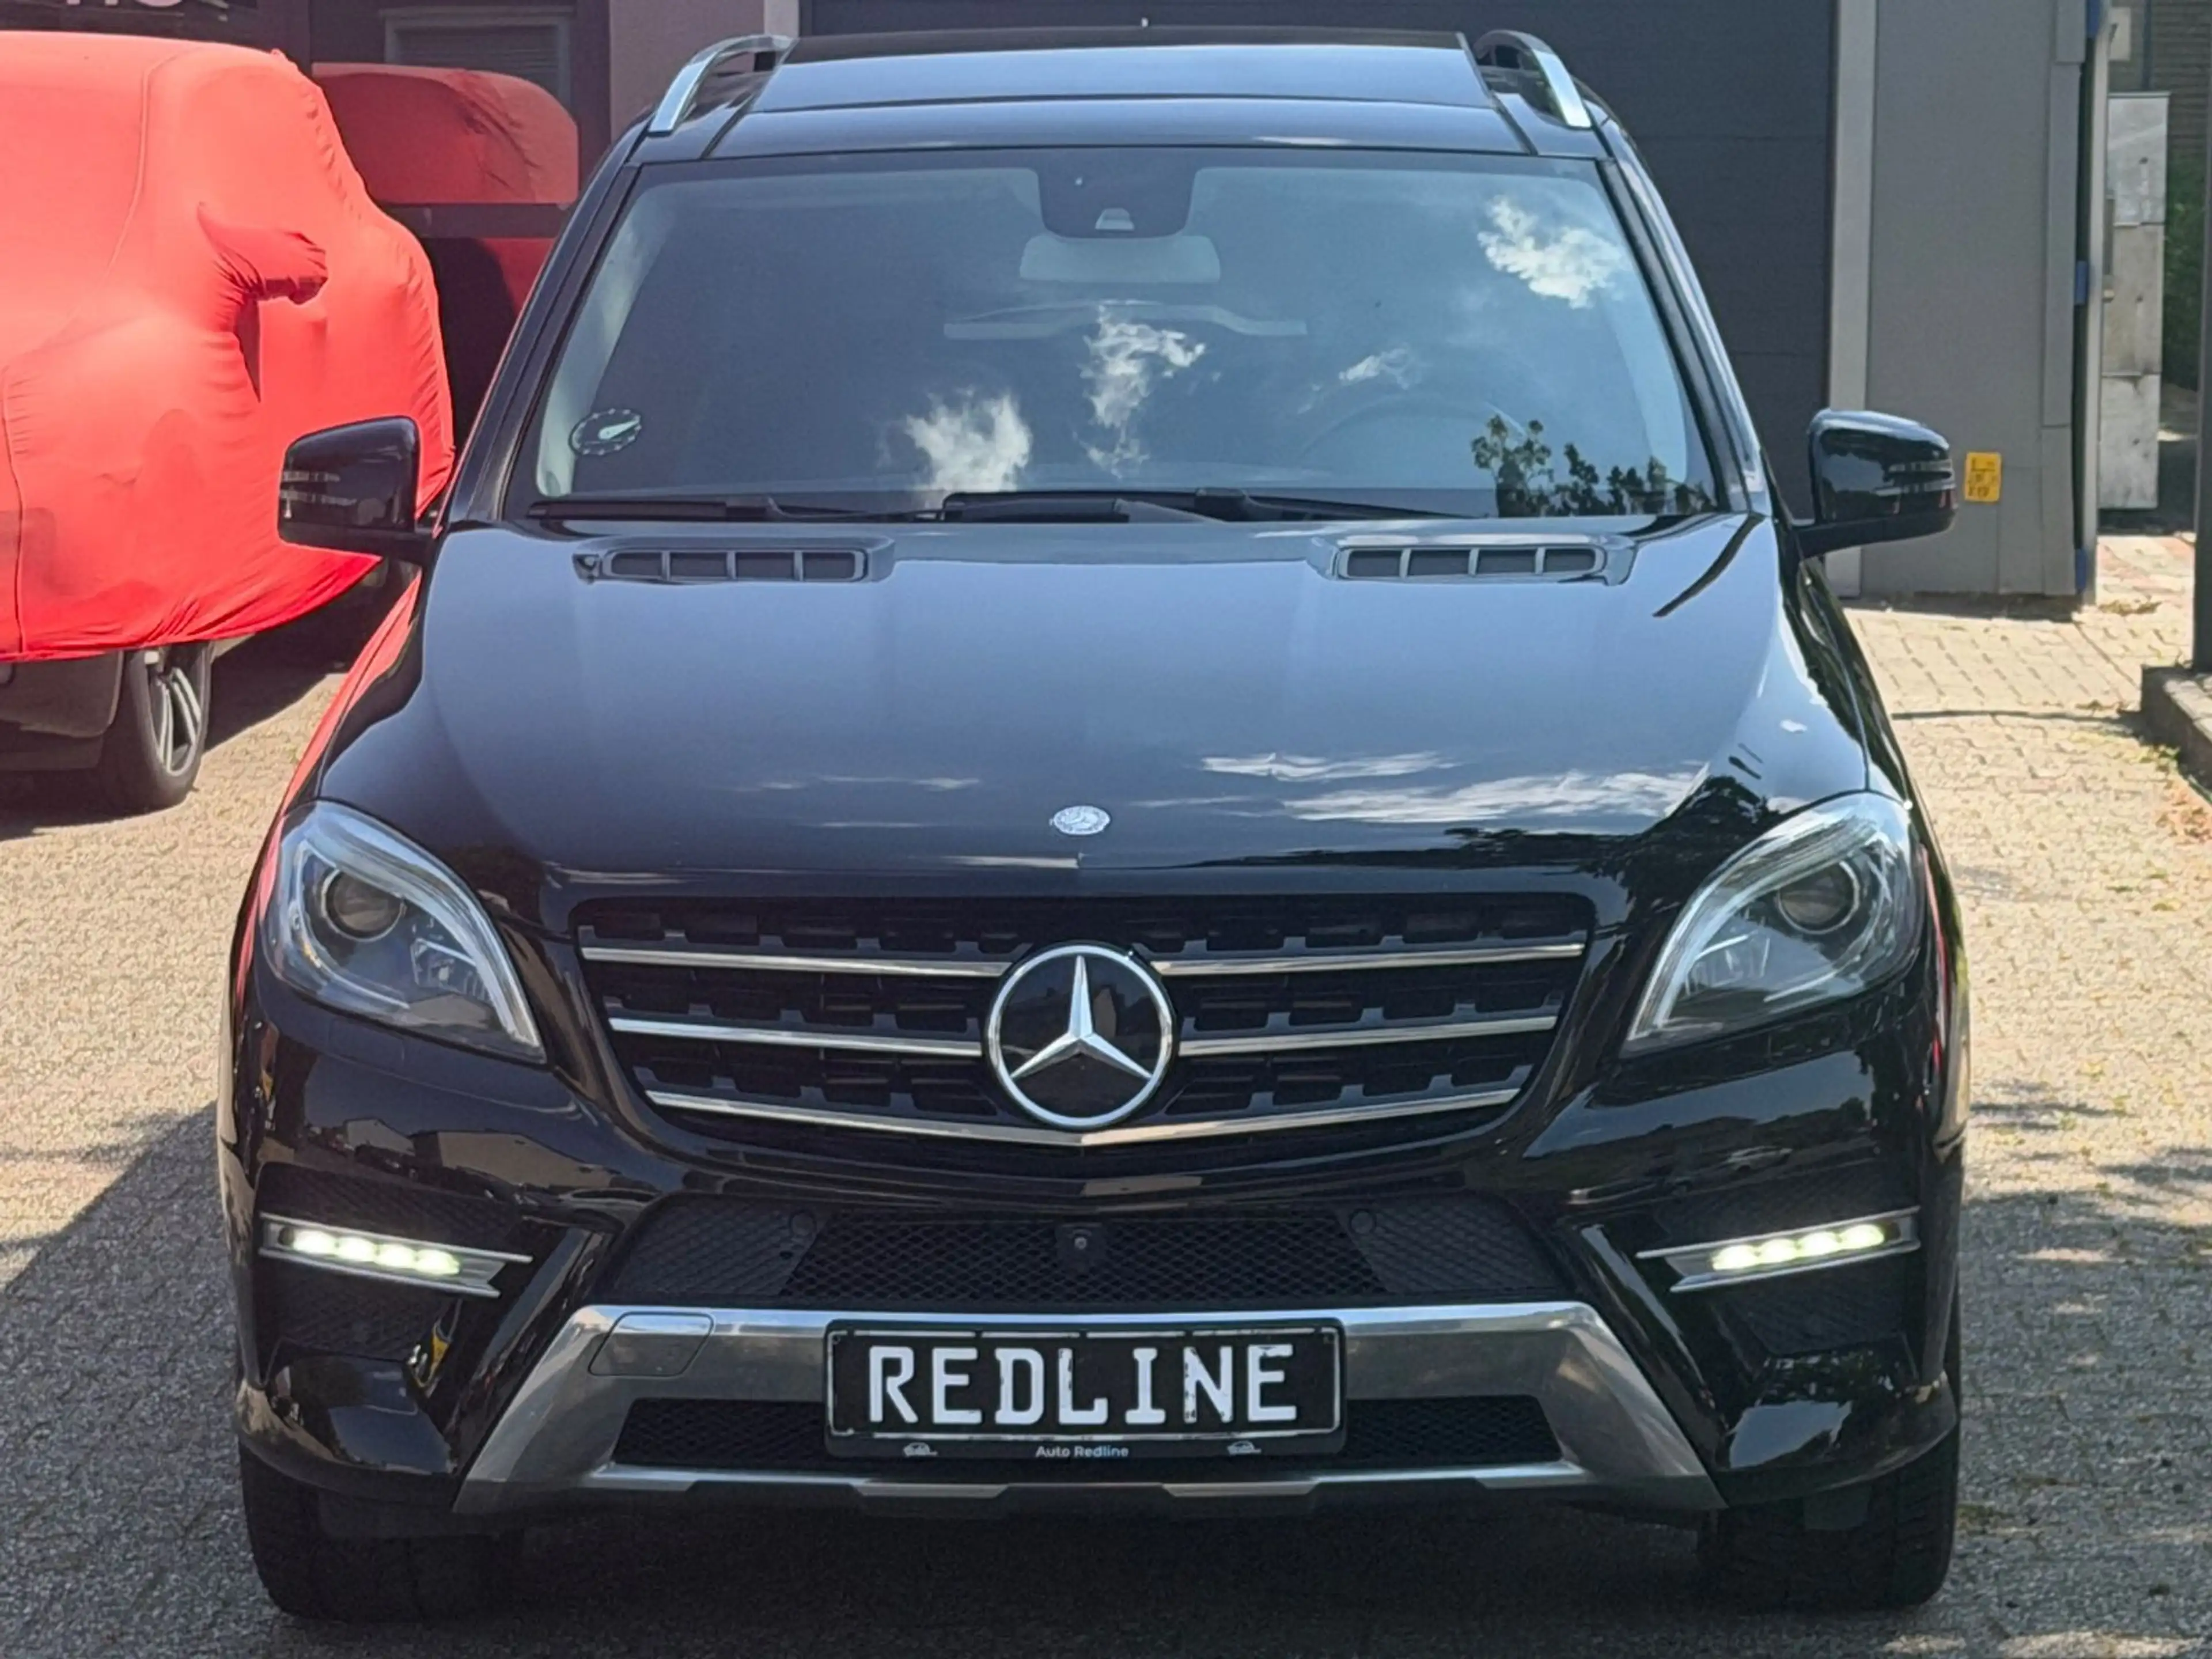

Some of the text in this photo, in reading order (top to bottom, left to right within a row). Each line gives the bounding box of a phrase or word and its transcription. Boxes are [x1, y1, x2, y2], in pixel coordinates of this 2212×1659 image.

[869, 1344, 1297, 1425] REDLINE
[1036, 1445, 1129, 1457] Auto Redline
